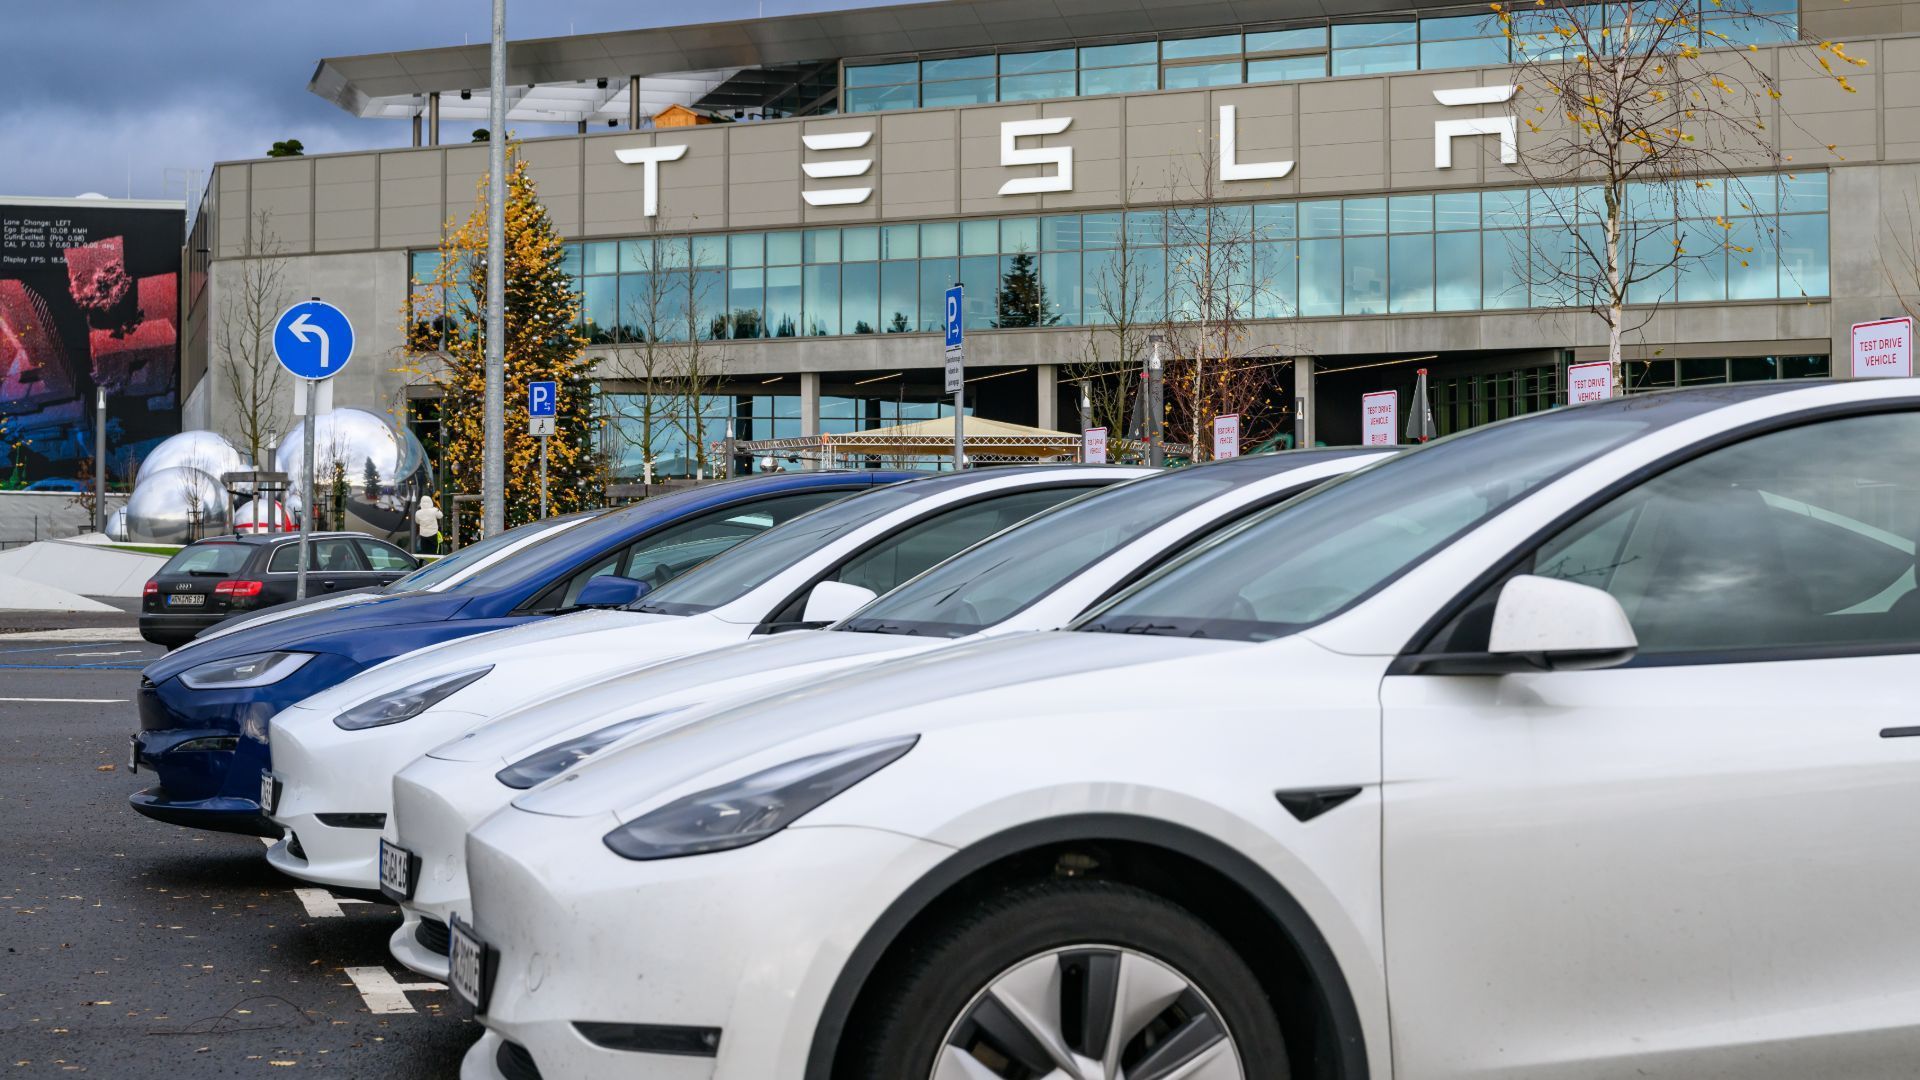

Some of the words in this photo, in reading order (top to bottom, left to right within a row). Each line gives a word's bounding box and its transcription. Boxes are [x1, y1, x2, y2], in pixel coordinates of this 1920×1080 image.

[615, 84, 1518, 217] TESLA
[3, 226, 17, 234] Ego
[23, 219, 51, 228] Change:
[3, 256, 27, 264] Display
[948, 296, 957, 339] P
[1860, 340, 1877, 352] TEST
[1879, 337, 1902, 350] DRIVE
[1864, 353, 1897, 367] VEHICLE
[1574, 379, 1587, 390] TEST
[1587, 377, 1605, 388] DRIVE
[533, 386, 547, 412] P
[1577, 391, 1601, 402] VEHICLE
